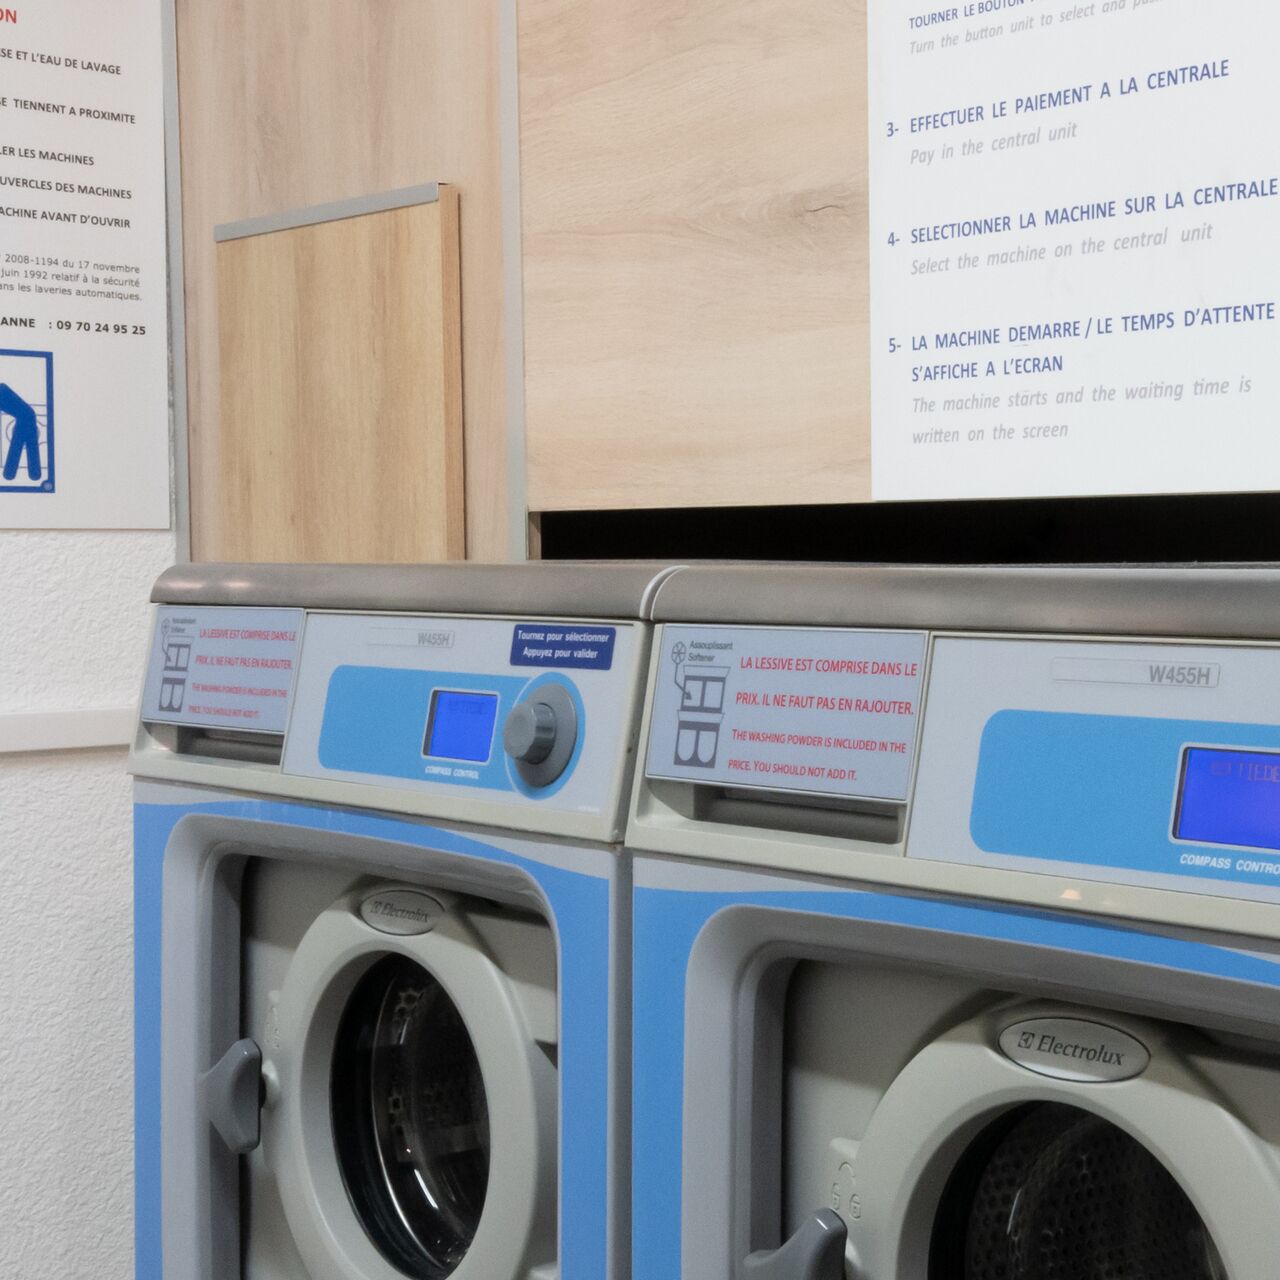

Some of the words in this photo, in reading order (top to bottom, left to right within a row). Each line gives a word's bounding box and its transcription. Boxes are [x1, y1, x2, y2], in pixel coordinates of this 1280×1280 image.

[15, 50, 28, 60] ET
[31, 53, 61, 66] L'EAU
[64, 58, 77, 68] DE
[81, 60, 120, 75] LAVAGE
[887, 122, 898, 137] 3-
[910, 105, 984, 133] EFFECTUER
[992, 101, 1006, 118] LE
[1015, 84, 1092, 114] PAIEMENT
[1100, 81, 1111, 98] A
[1120, 76, 1138, 95] LA
[1147, 59, 1229, 90] CENTRALE
[910, 148, 935, 166] Pay
[941, 143, 954, 159] in
[961, 138, 984, 156] the
[991, 127, 1041, 151] central
[1048, 122, 1077, 141] unit
[18, 148, 35, 158] LES
[38, 150, 94, 166] MACHINES
[5, 253, 59, 266] 2008-1194
[62, 259, 74, 268] du
[78, 260, 89, 269] 17
[92, 263, 140, 274] novembre
[56, 320, 72, 330] 09
[76, 321, 90, 331] 70
[95, 322, 109, 332] 24
[113, 324, 127, 334] 95
[132, 325, 146, 335] 25
[889, 337, 901, 353] 5-
[912, 335, 927, 350] LA
[935, 328, 1000, 348] MACHINE
[1008, 320, 1080, 342] DEMARRE
[1084, 317, 1092, 338] /
[1097, 317, 1112, 334] LE
[1121, 311, 1174, 332] TEMPS
[1184, 302, 1274, 326] D'ATTENTE
[912, 362, 977, 382] S'AFFICHE
[985, 361, 995, 376] A
[1003, 355, 1062, 375] L'ECRAN
[912, 427, 959, 444] written
[967, 429, 984, 441] on
[992, 423, 1015, 440] the
[1022, 424, 1068, 438] screen
[518, 630, 544, 640] Tournez
[547, 633, 562, 643] pour
[565, 632, 608, 643] sélectionner
[523, 647, 552, 657] Appuyez
[555, 650, 570, 659] pour
[573, 650, 598, 659] valider
[741, 657, 752, 668] LA
[756, 657, 792, 671] LESSIVE
[795, 659, 813, 671] EST
[815, 659, 868, 674] COMPRISE
[871, 662, 901, 676] DANS
[905, 663, 917, 676] LE
[1148, 662, 1211, 686] W455H
[736, 692, 759, 705] PRIX.
[762, 693, 770, 705] IL
[773, 694, 786, 706] NE
[789, 695, 815, 708] FAUT
[817, 697, 835, 710] PAS
[838, 698, 852, 711] EN
[854, 699, 914, 715] RAJOUTER.
[425, 765, 451, 775] COMPASS
[453, 768, 479, 779] CONTROL
[1180, 854, 1231, 869] COMPASS
[381, 903, 430, 923] Electrolux
[1037, 1035, 1124, 1065] Electrolux
